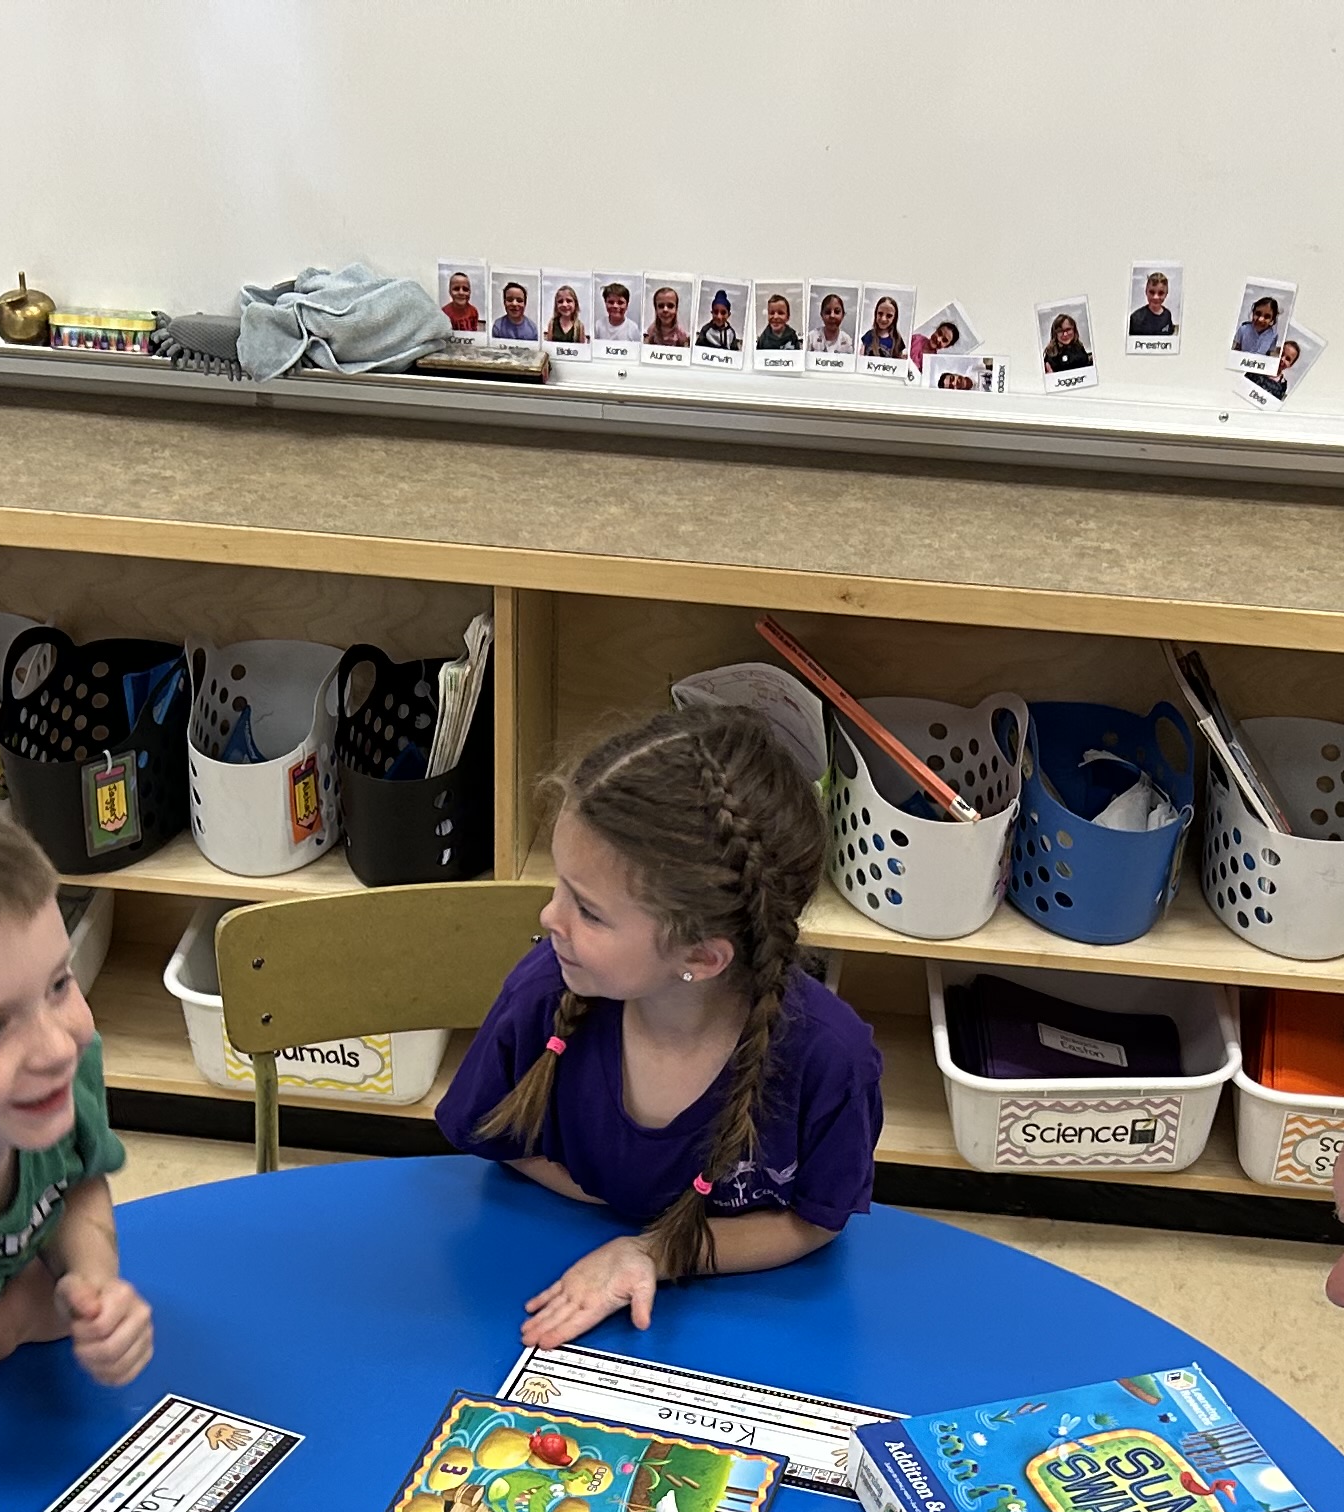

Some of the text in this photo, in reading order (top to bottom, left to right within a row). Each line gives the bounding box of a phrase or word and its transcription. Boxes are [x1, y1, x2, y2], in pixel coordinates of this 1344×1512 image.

[606, 346, 627, 355] Kane
[1135, 341, 1172, 351] Preston
[1055, 374, 1086, 388] Jagger
[1021, 1122, 1129, 1145] Science
[1192, 1388, 1221, 1422] Learning
[657, 1406, 757, 1446] Kensie
[438, 1462, 469, 1477] 3
[585, 1466, 608, 1493] ODDS
[884, 1440, 934, 1500] Addition
